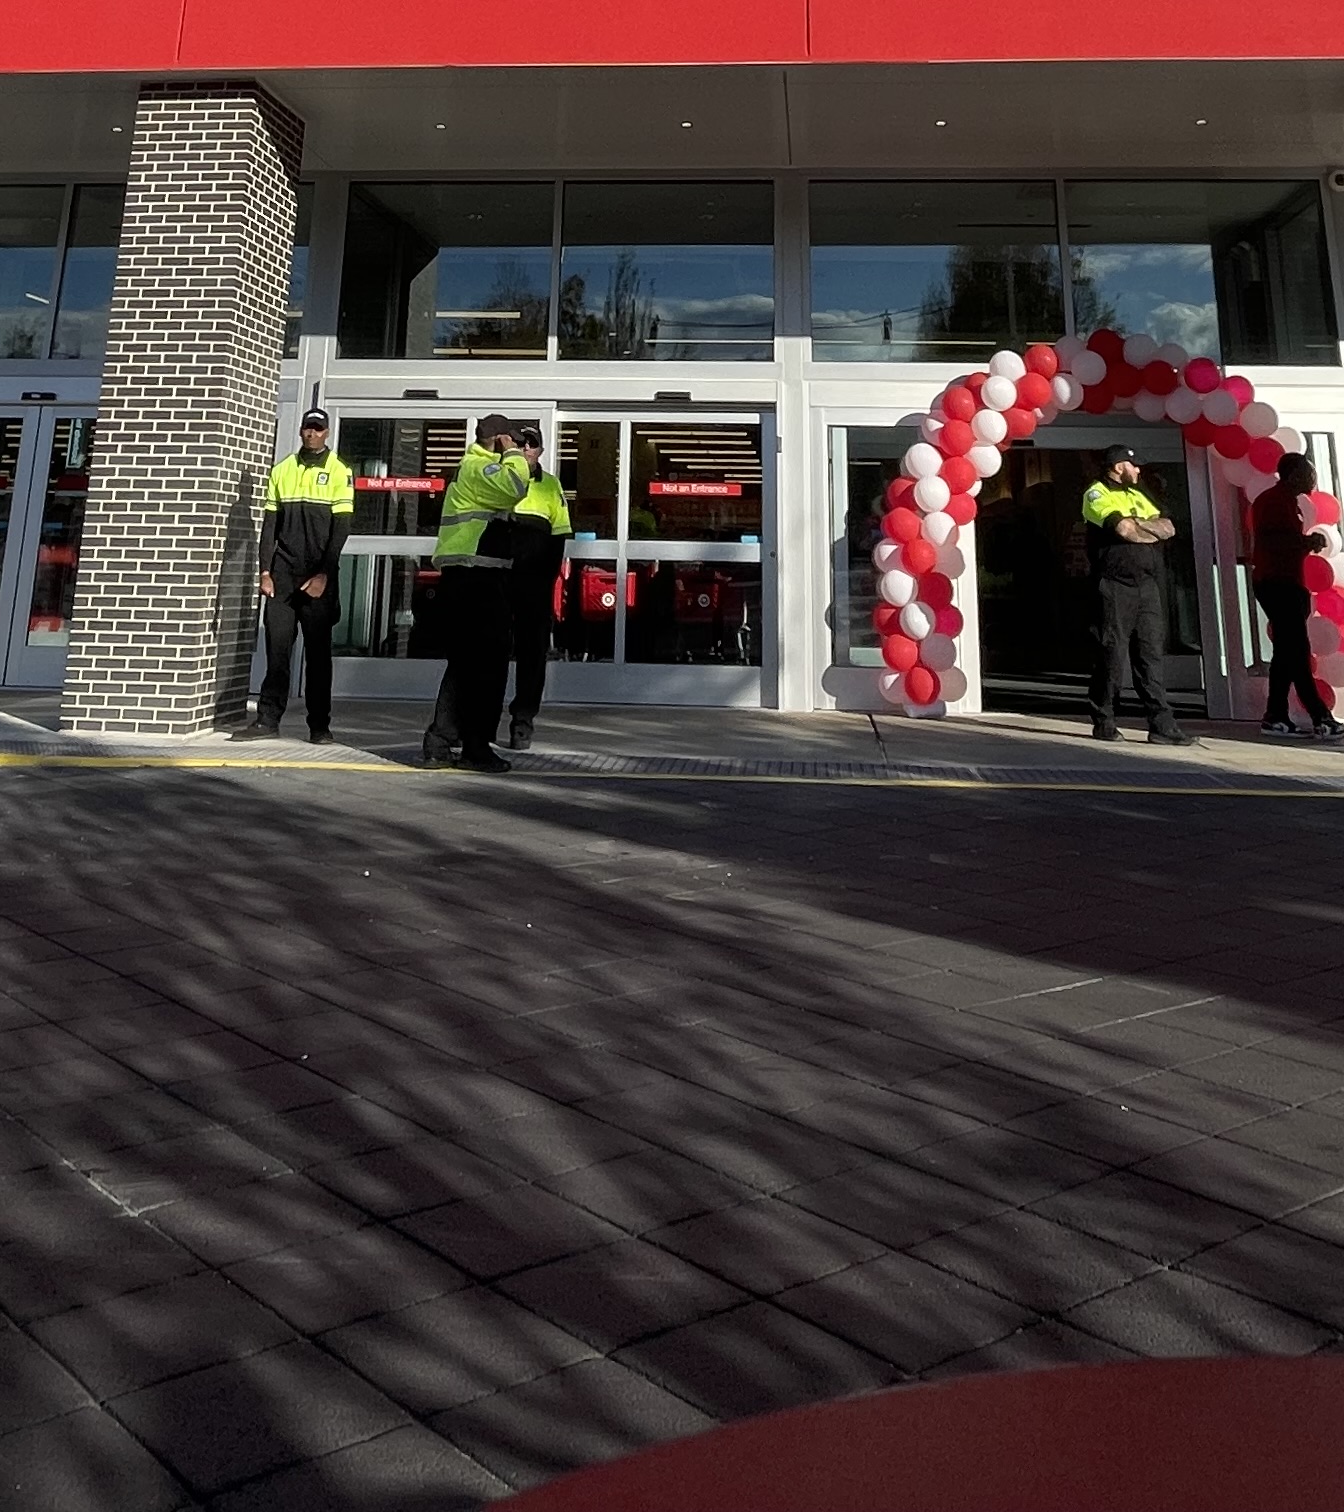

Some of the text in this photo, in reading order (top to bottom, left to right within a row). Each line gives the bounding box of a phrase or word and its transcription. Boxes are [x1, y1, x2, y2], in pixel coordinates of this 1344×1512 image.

[367, 479, 432, 488] Not an Entrance
[662, 484, 677, 492] Not
[691, 484, 728, 493] Entrance
